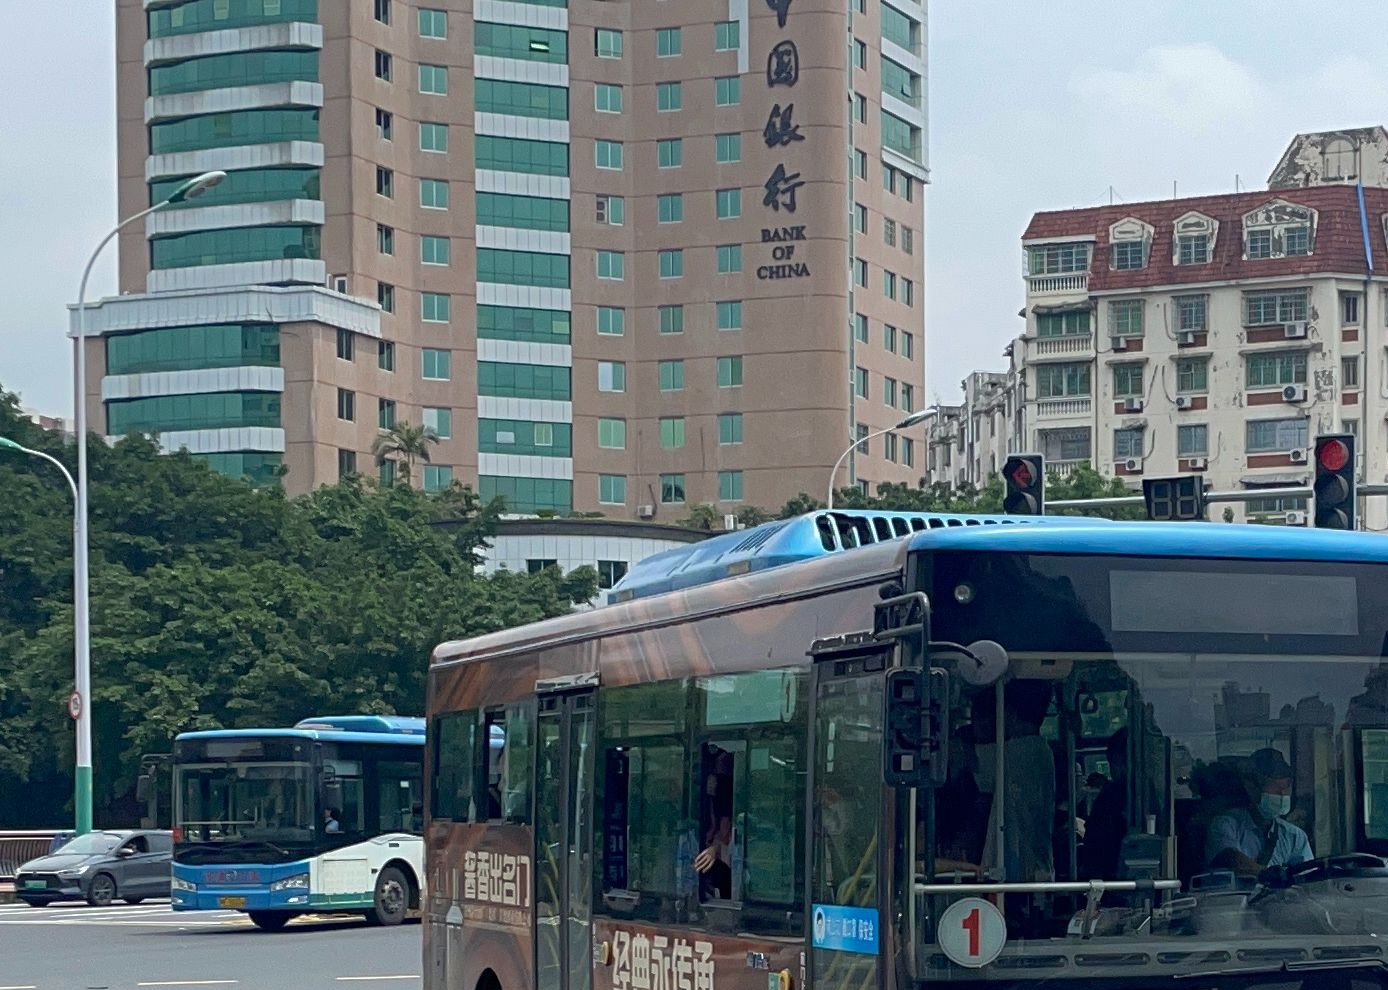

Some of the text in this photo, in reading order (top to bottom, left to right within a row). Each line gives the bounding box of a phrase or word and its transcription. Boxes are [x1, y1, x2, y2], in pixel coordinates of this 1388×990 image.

[761, 226, 806, 243] BANK
[772, 246, 795, 261] OF
[757, 263, 810, 280] CHINA
[961, 909, 981, 957] 1
